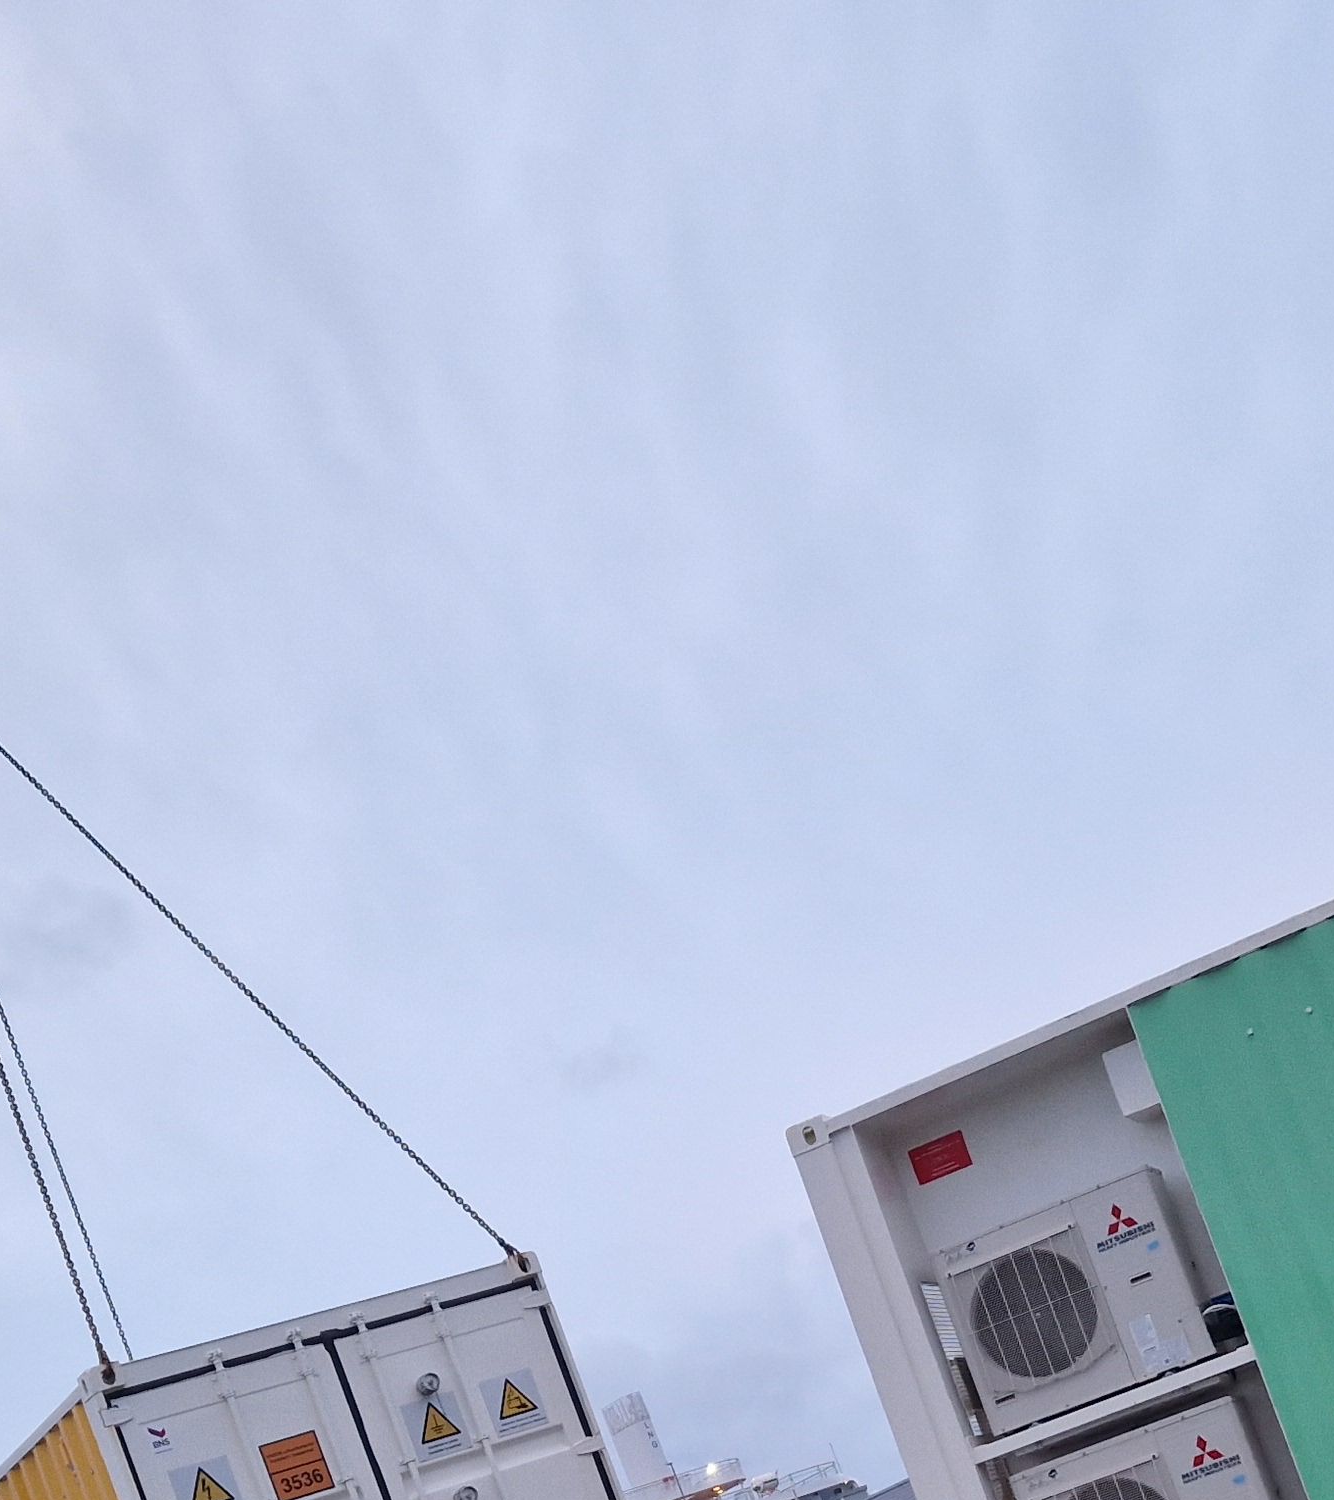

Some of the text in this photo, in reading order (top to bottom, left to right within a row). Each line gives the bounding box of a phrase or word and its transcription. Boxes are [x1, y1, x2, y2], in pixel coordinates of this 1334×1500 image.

[1097, 1221, 1155, 1249] MITSUBISHI
[1181, 1454, 1240, 1480] MITSUBISHI
[281, 1469, 324, 1493] 3536
